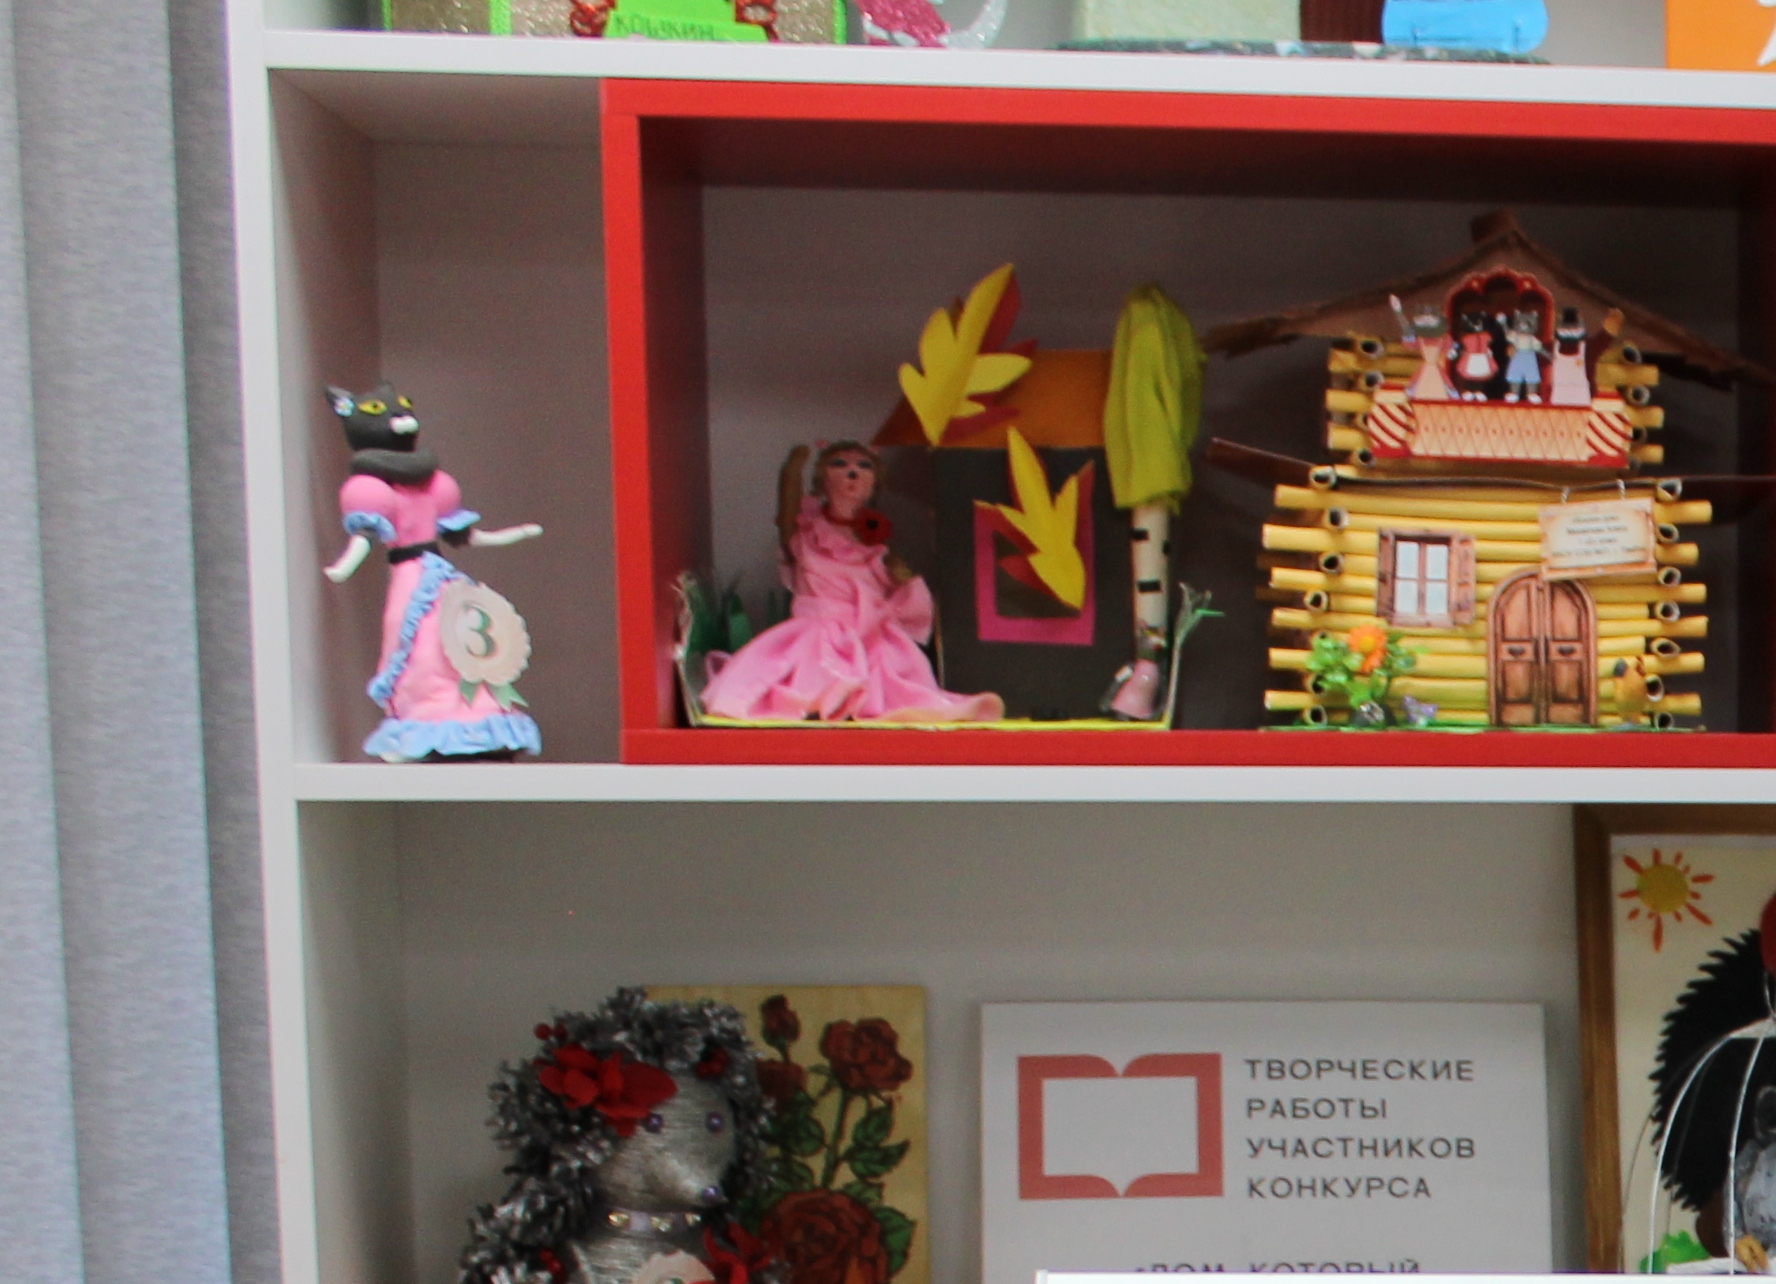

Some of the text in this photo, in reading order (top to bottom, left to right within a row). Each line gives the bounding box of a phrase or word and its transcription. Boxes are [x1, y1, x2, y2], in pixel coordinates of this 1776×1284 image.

[462, 602, 497, 659] 3
[1244, 1058, 1474, 1081] ТВОРЧЕСКИЕ
[1246, 1098, 1387, 1120] РАБОТЫ
[1246, 1137, 1475, 1159] УЧАСТНИКОВ
[1247, 1176, 1431, 1199] КОНКУРСА
